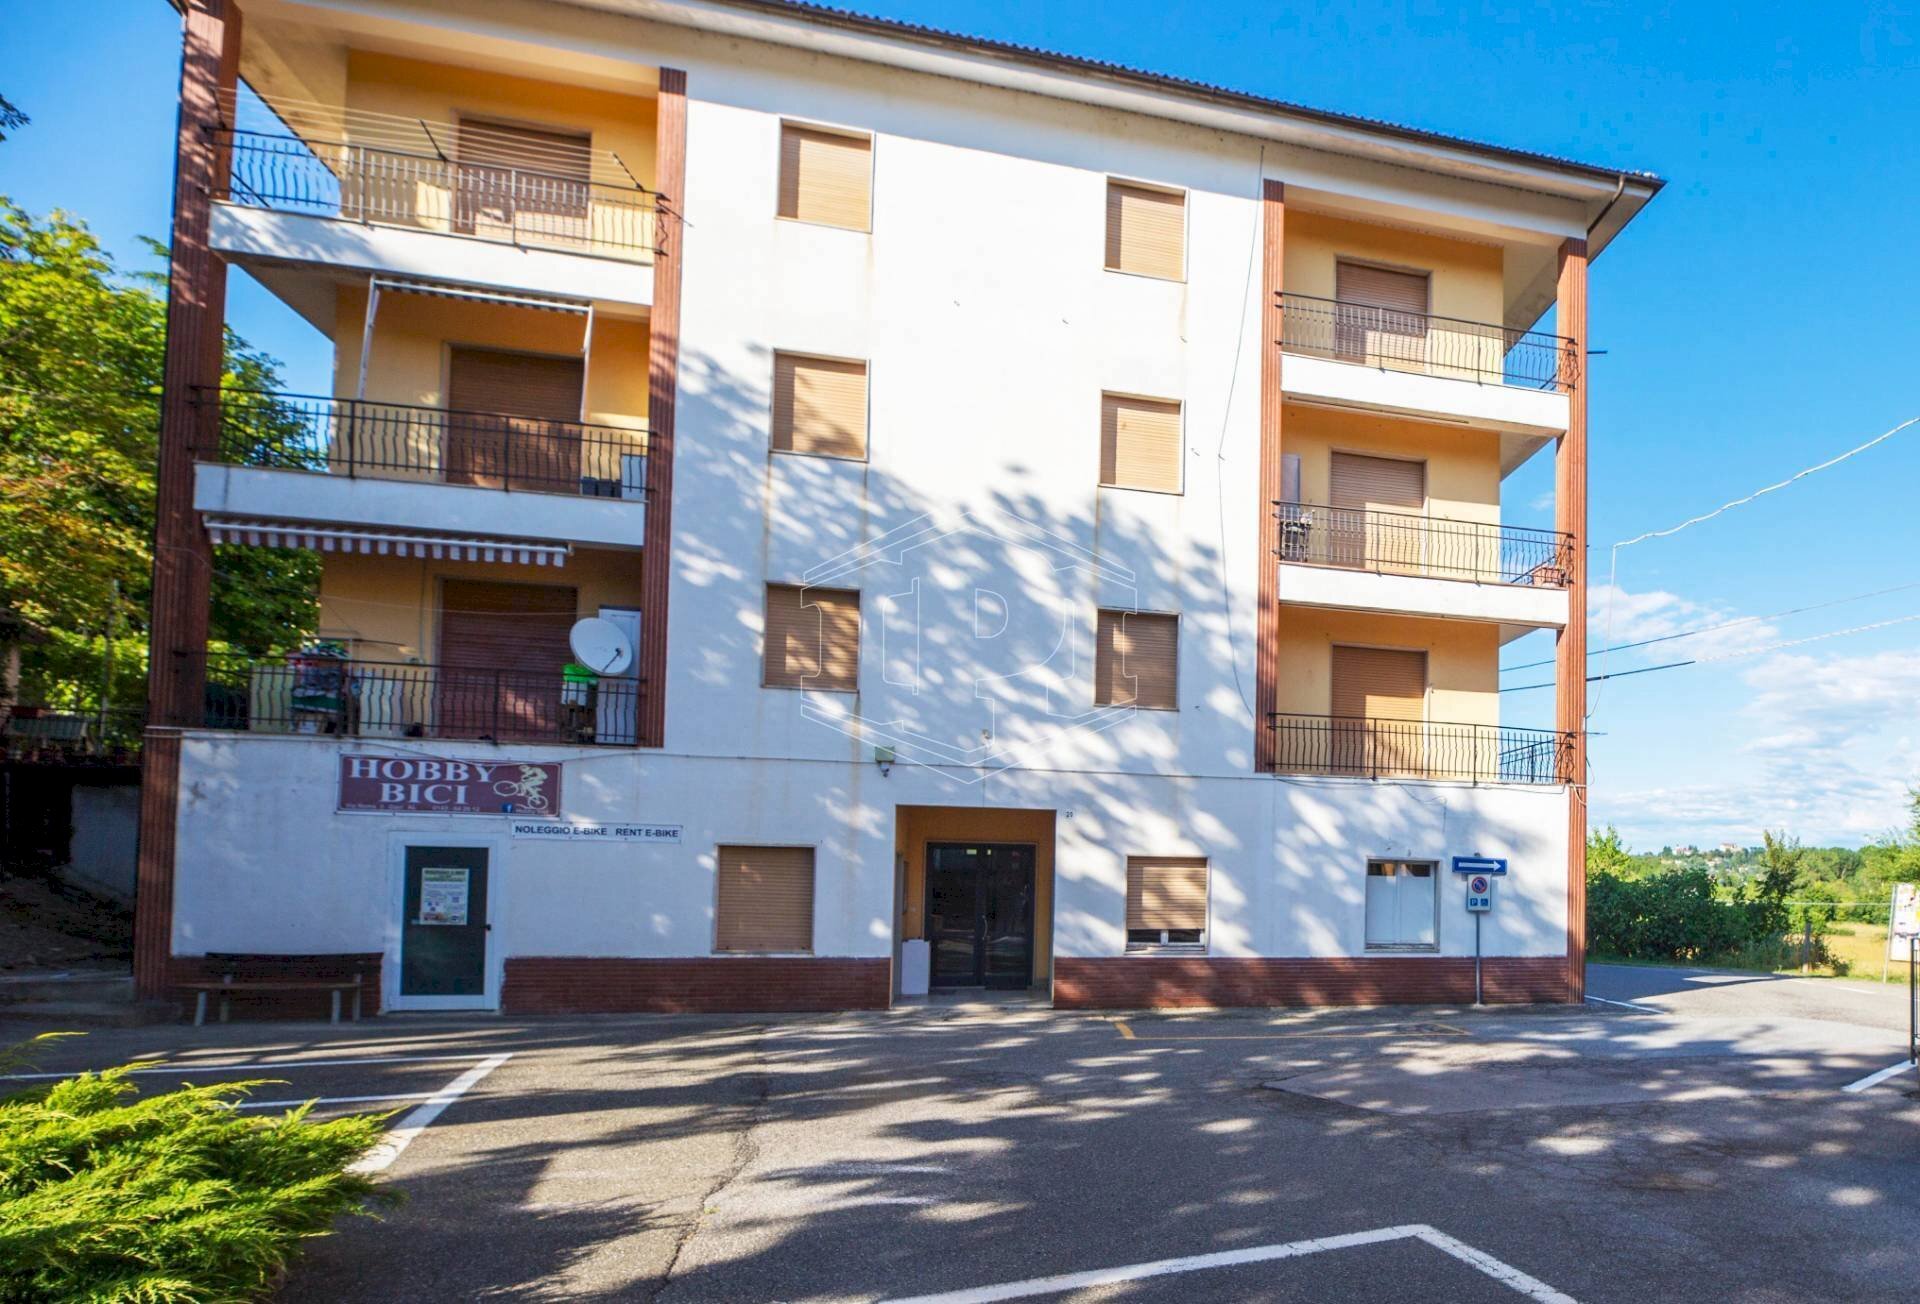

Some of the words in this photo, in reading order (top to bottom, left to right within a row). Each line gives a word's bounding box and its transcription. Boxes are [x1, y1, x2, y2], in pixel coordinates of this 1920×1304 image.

[350, 758, 496, 783] HOBBY
[379, 782, 469, 805] BICI
[515, 825, 570, 835] NOLEGGIO
[573, 827, 608, 836] E-BIKE
[615, 828, 642, 836] RENT
[645, 829, 679, 837] E-BIKE
